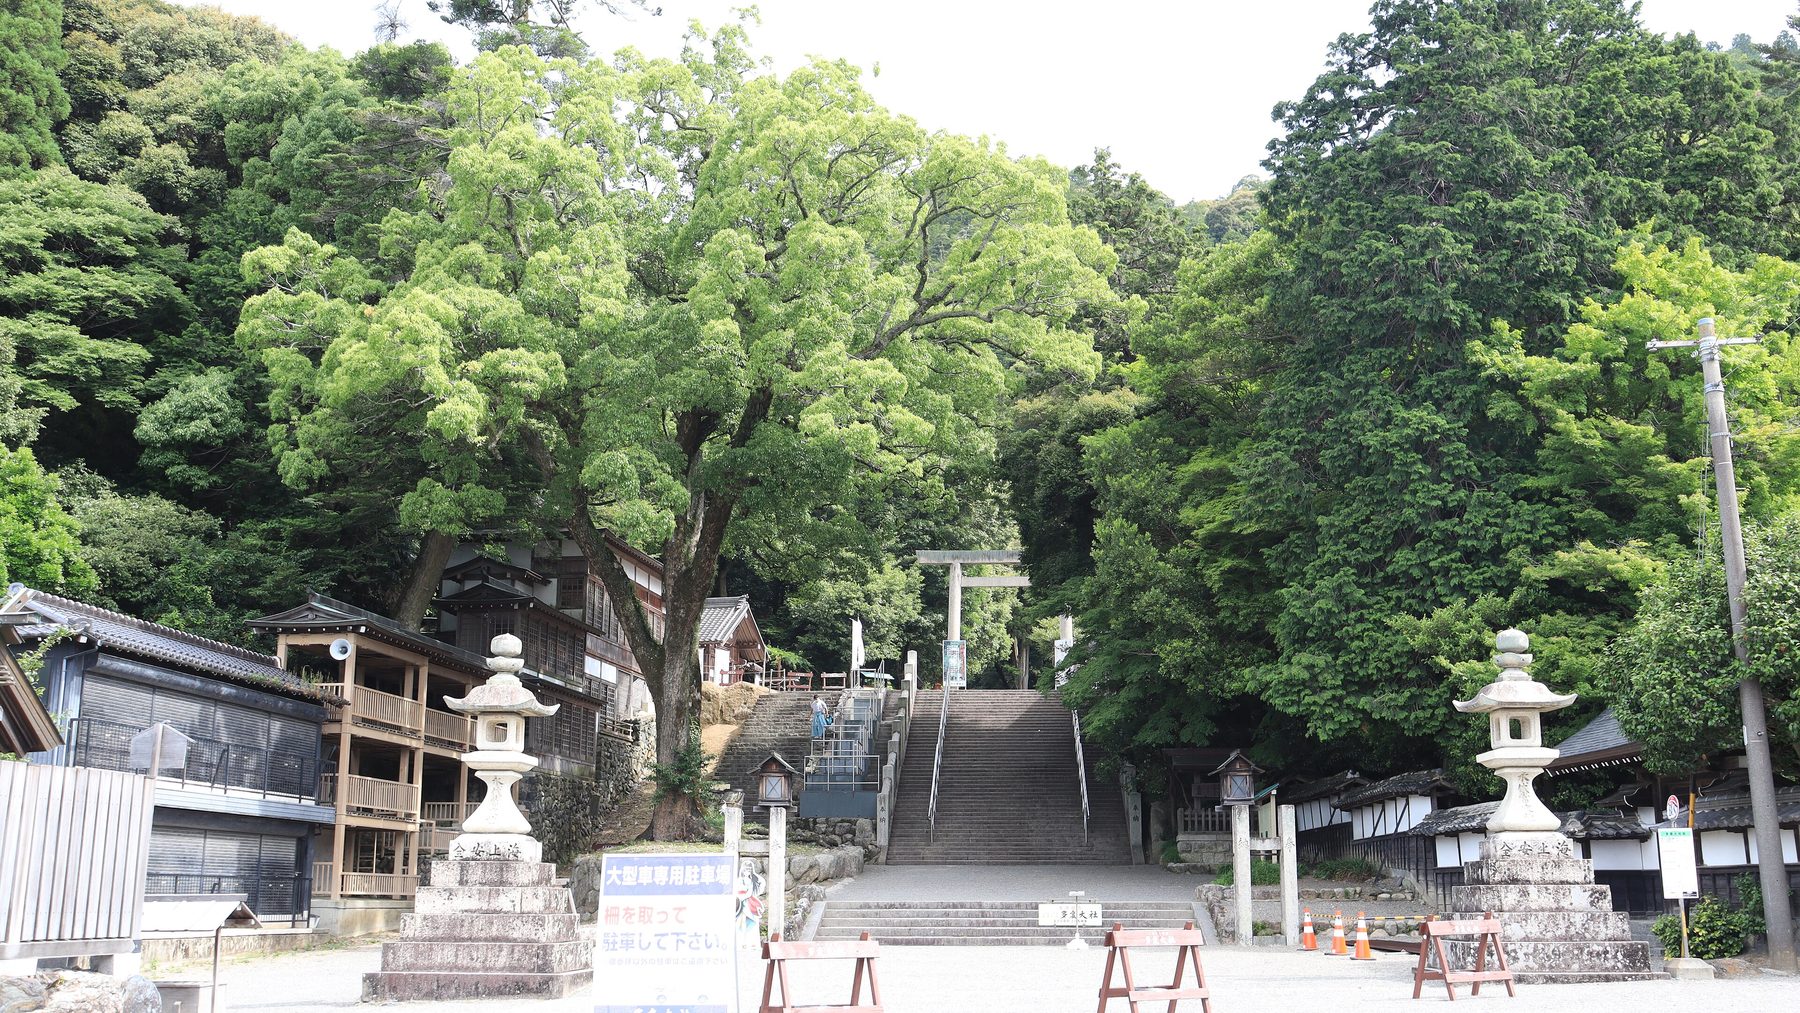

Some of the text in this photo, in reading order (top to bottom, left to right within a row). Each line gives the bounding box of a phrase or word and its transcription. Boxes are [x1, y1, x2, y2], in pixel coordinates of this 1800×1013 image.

[1500, 840, 1572, 858] 海上安全
[606, 865, 731, 886] 大型車専用駐車場
[604, 906, 687, 925] 柵を取って
